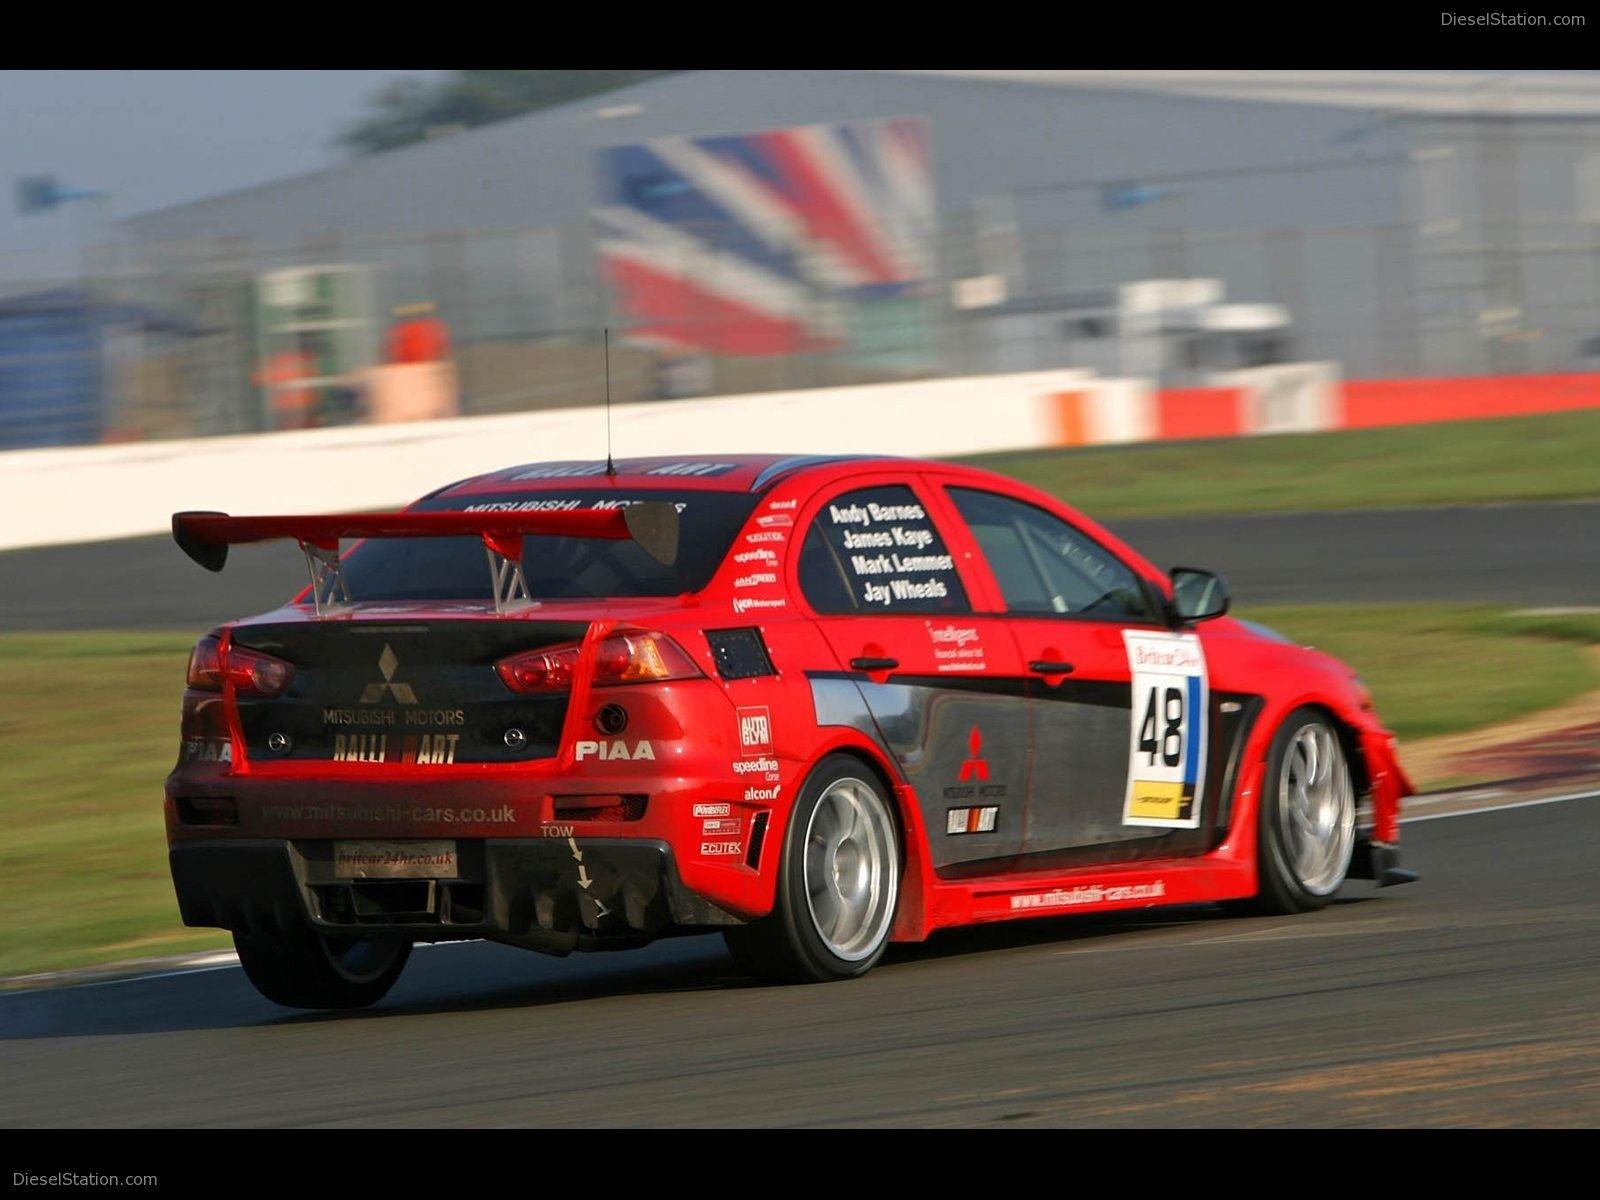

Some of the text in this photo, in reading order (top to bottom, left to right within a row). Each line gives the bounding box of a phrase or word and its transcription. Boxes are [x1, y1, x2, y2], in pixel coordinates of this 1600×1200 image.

[829, 502, 926, 527] Andy Barnes
[843, 526, 934, 550] James Kaye
[850, 553, 954, 575] Mark Lemmer
[863, 578, 948, 605] Jay Wheals
[322, 709, 466, 726] MITSUBISHI MOTORS
[741, 715, 768, 731] AUTO
[1138, 686, 1183, 768] 48
[742, 729, 769, 746] GLYM
[333, 734, 461, 765] RALLI ART
[575, 741, 655, 761] PIAA
[732, 757, 779, 775] speedline
[744, 786, 772, 801] alcon
[260, 803, 516, 824] www.mitsubishi-cars.co.uk
[541, 826, 574, 838] TOW
[701, 842, 741, 855] ECUTEK
